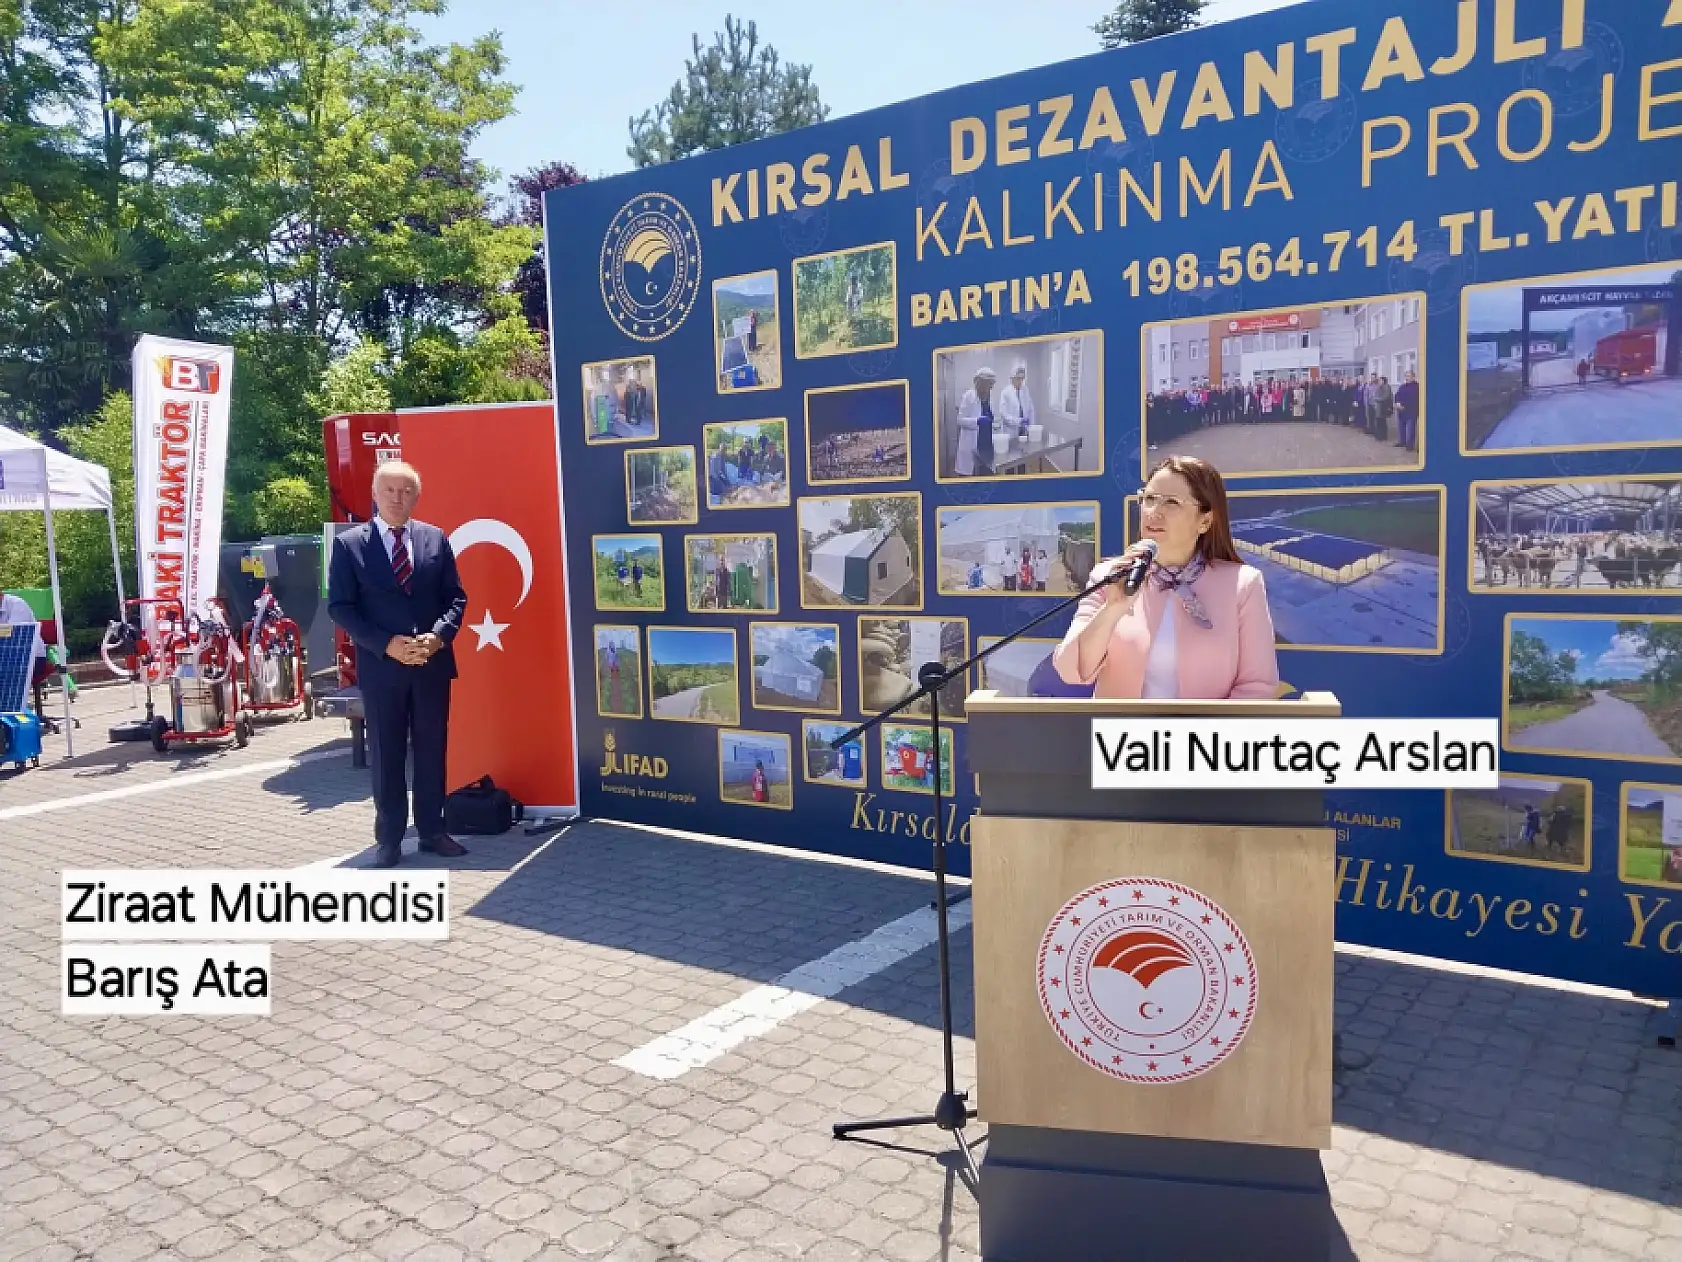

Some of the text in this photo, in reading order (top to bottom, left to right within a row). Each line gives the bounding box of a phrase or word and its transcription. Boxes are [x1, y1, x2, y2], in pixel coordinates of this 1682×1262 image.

[712, 0, 1585, 227] KIRSAL DEZAVANTAJLI
[915, 58, 1682, 261] KALKINMA PROJE
[910, 268, 1092, 327] BARTIN'A
[1122, 219, 1418, 297] 198.564.714
[153, 400, 192, 543] TRAKTÖR
[1333, 810, 1401, 831] ALANLAR
[1119, 911, 1164, 924] TARIM
[1168, 918, 1184, 931] VE
[1184, 929, 1218, 976] ORMAN
[1334, 856, 1588, 938] Hikayesi
